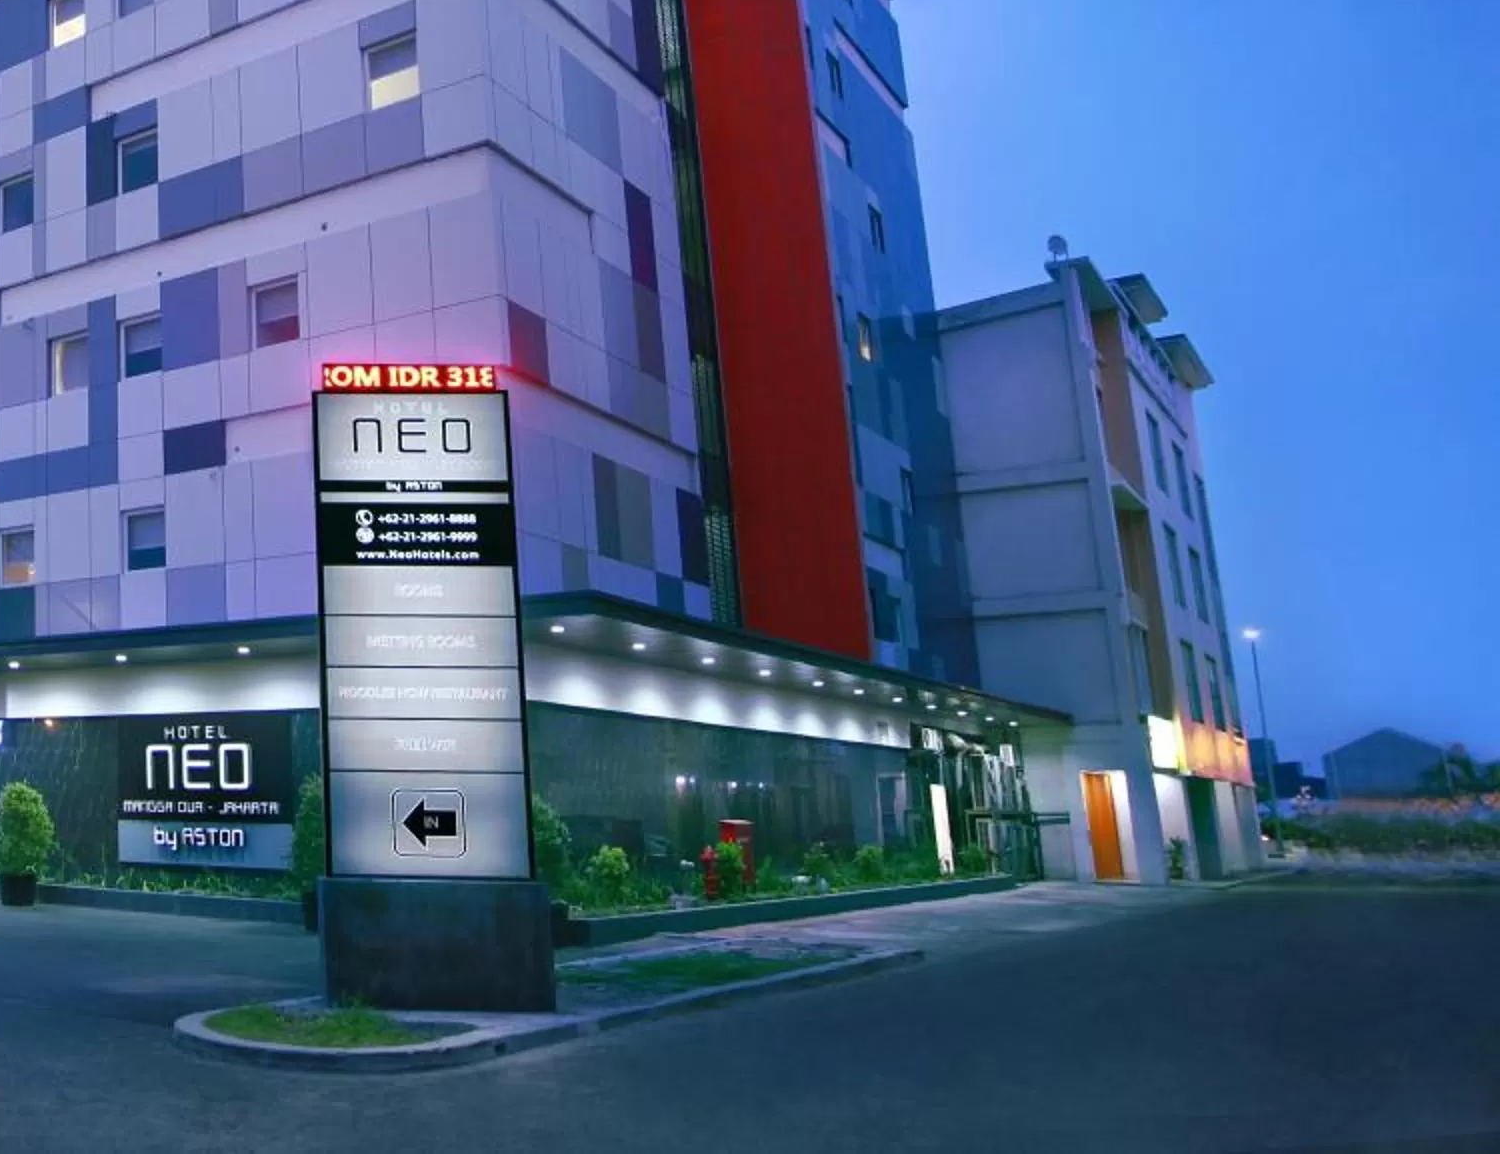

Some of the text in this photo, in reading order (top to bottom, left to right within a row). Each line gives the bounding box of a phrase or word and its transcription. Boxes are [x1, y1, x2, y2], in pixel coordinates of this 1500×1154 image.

[389, 366, 441, 387] IDR
[164, 725, 228, 739] HOTEL
[123, 800, 173, 813] MANGGA
[177, 801, 204, 813] DUA
[219, 801, 279, 815] JAKARTA
[424, 816, 438, 828] IN
[153, 827, 244, 851] by ASTON
